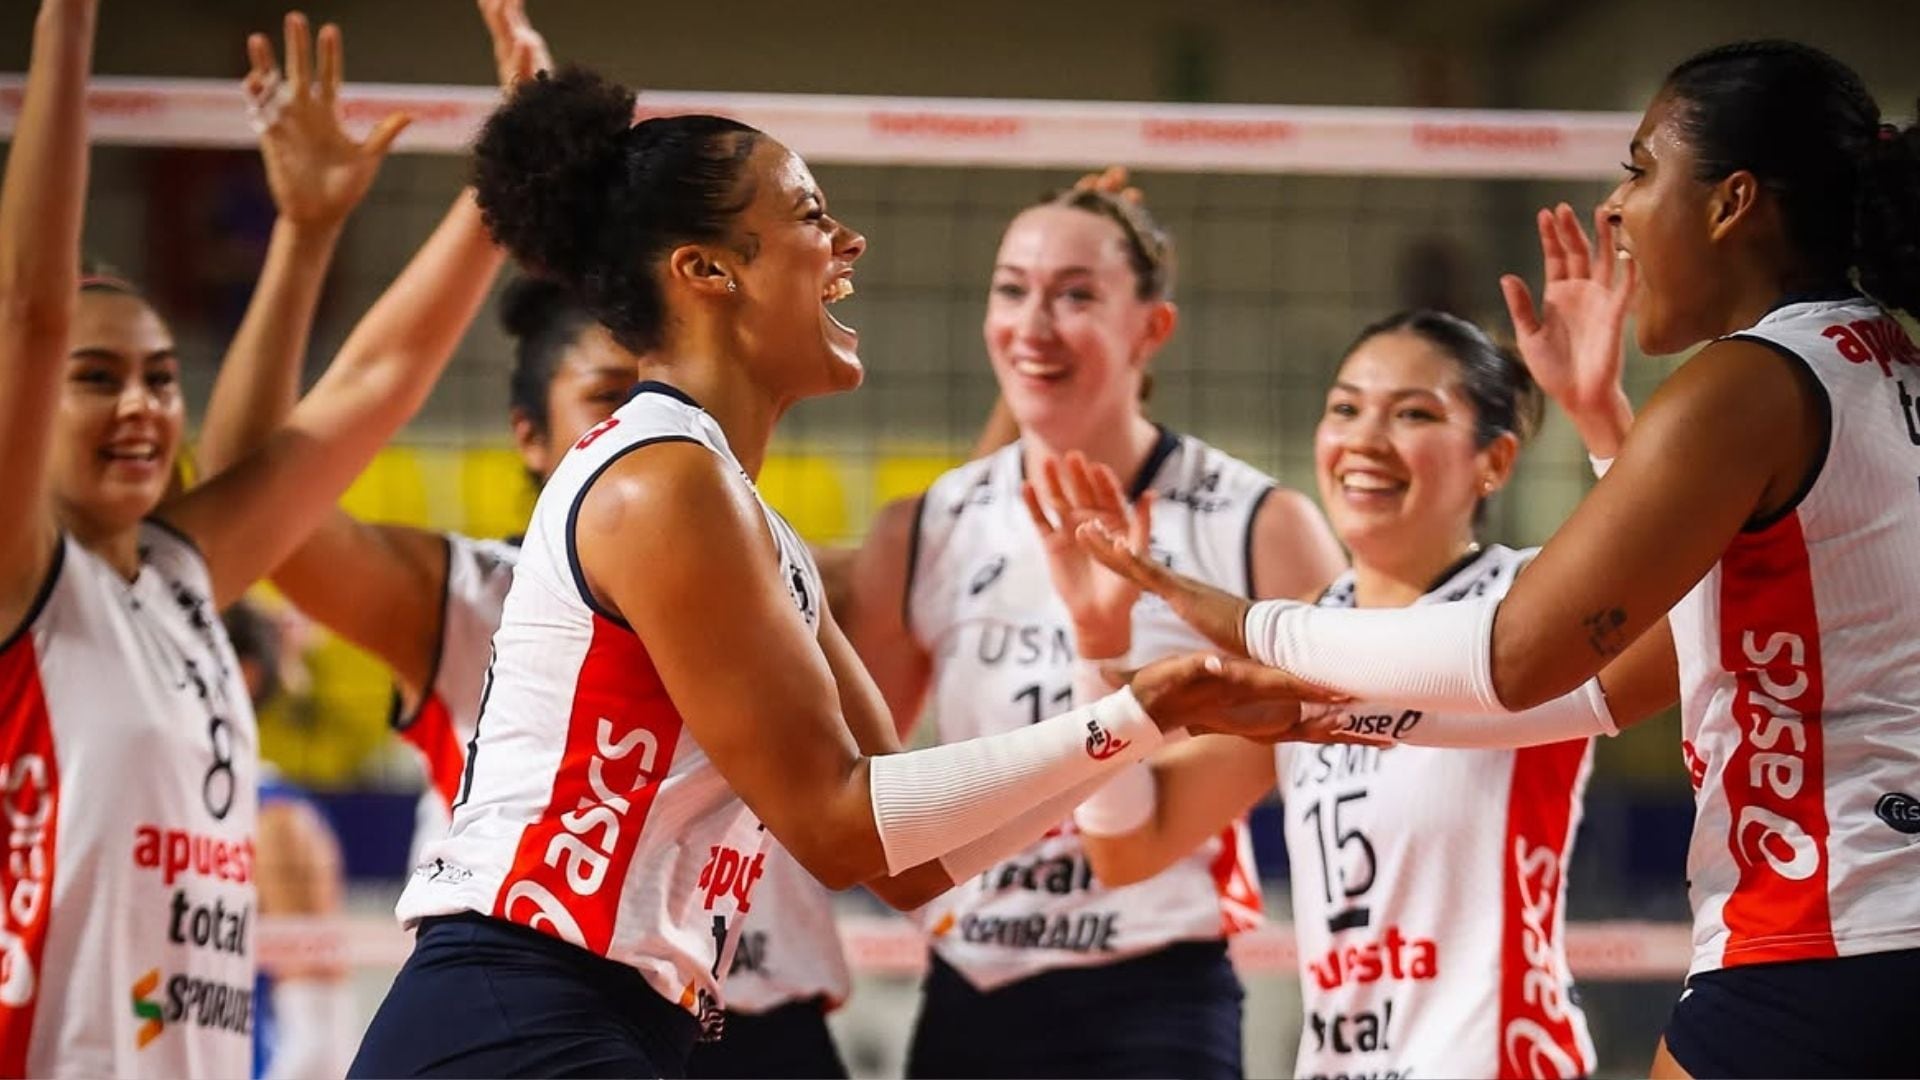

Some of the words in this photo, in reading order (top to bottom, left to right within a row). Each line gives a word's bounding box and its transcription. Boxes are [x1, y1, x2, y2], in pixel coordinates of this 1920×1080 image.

[1342, 713, 1393, 735] asic
[1742, 629, 1807, 799] asics
[203, 717, 236, 820] 8
[544, 717, 658, 896] asics
[1304, 790, 1376, 904] 15
[169, 890, 247, 956] total
